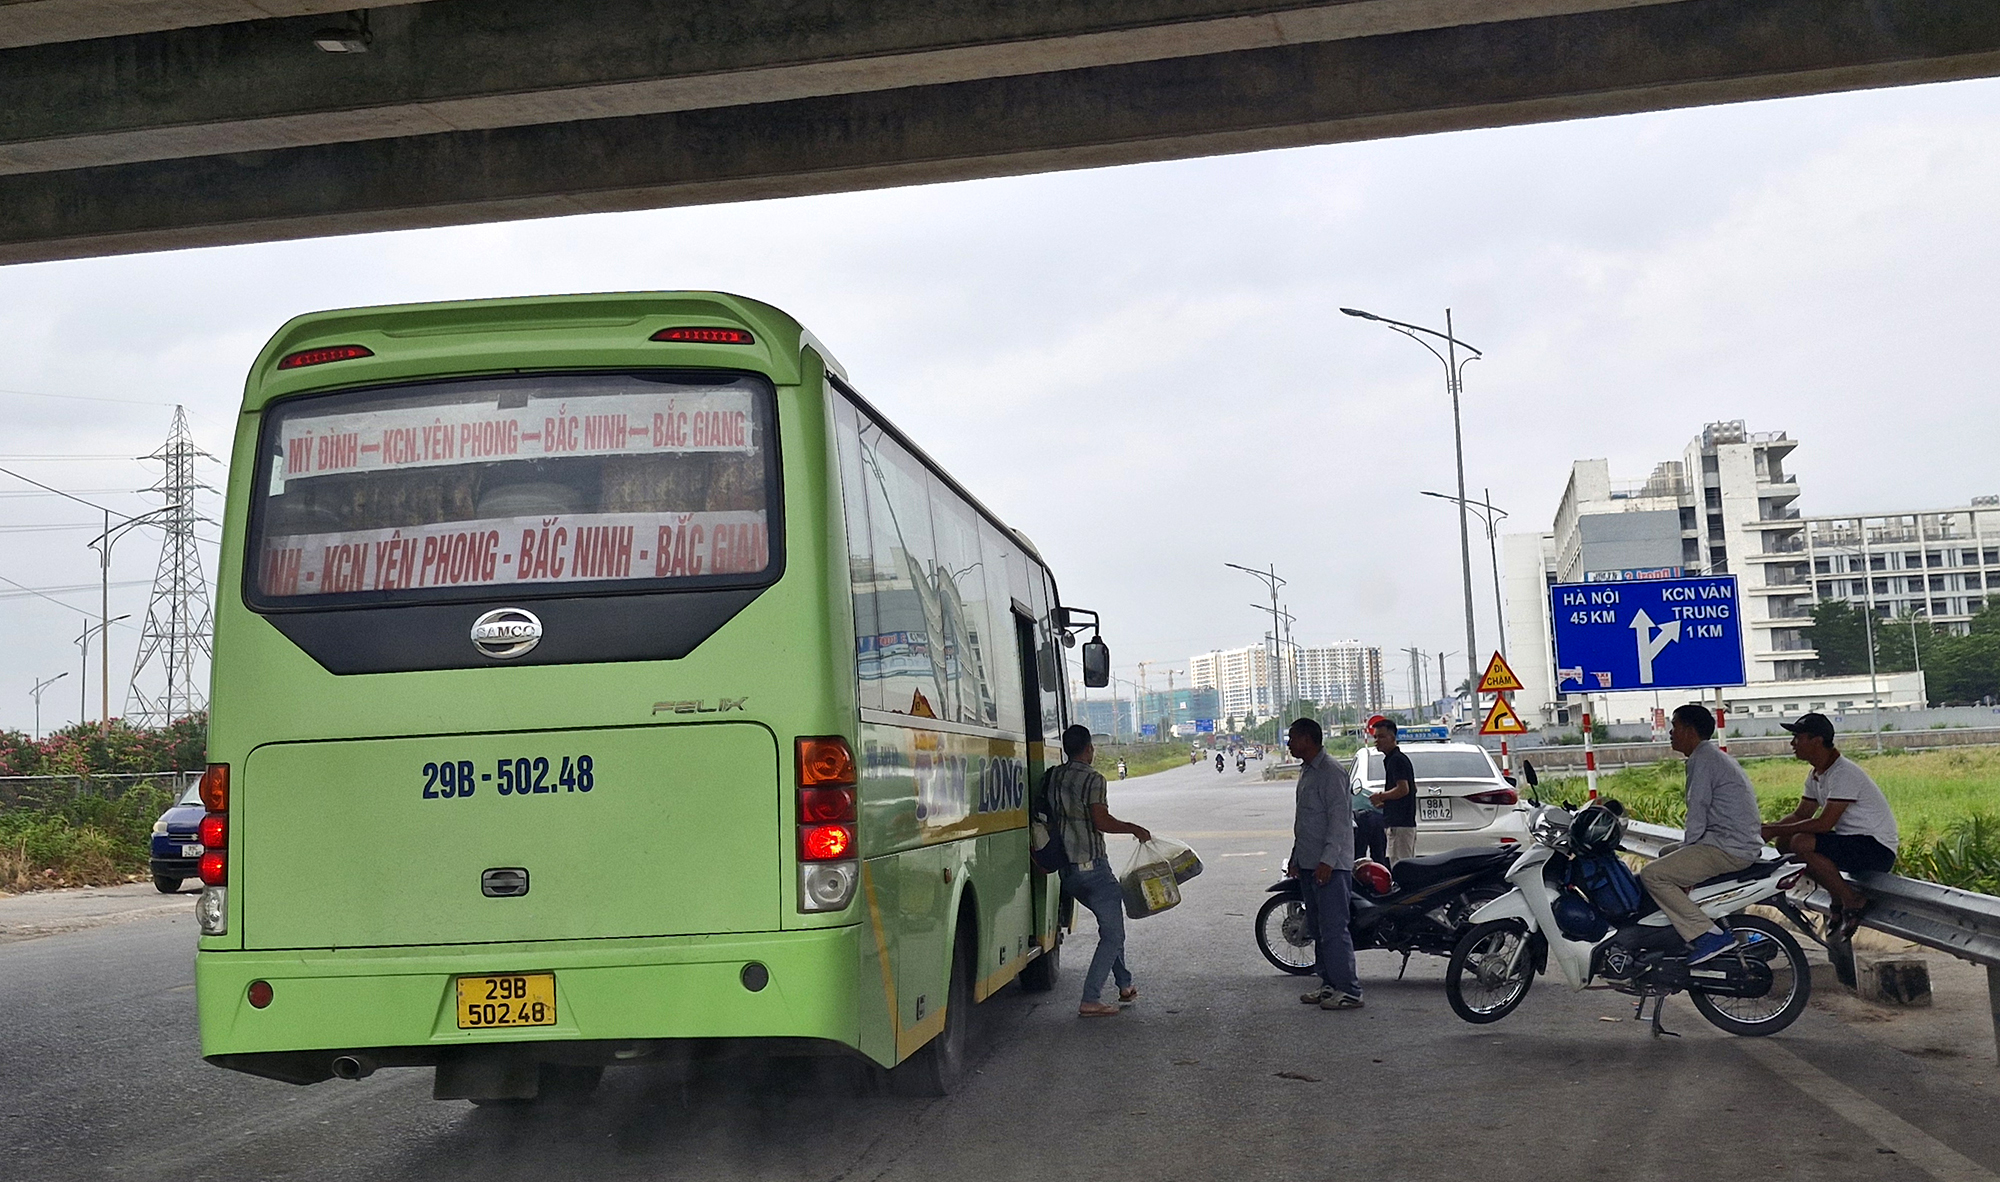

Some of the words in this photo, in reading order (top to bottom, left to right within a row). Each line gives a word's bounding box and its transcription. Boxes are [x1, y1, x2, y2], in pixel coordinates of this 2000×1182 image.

[544, 403, 580, 453] BẮC
[584, 414, 627, 451] NINH
[653, 399, 687, 448] BẮC
[692, 411, 745, 448] GIANG
[459, 419, 519, 459] PHONG
[288, 430, 314, 475] MỸ
[317, 427, 359, 471] ĐÌNH
[320, 543, 369, 594] KCN
[373, 530, 418, 591] YÊN
[418, 530, 500, 587] PHONG
[516, 517, 568, 580] BẮC
[571, 526, 634, 578] NINH
[655, 513, 704, 578] BẮC
[1563, 588, 1587, 606] HÀ
[1591, 587, 1620, 608] NỘI
[1662, 587, 1695, 602] KCN
[1698, 582, 1732, 600] VÂN
[1570, 611, 1588, 625] 45
[1590, 609, 1616, 624] KM
[1671, 604, 1730, 620] TRUNG
[475, 623, 537, 640] SAMCO
[1686, 625, 1694, 639] 1
[1697, 624, 1724, 638] KM
[1494, 664, 1503, 673] ĐI
[652, 696, 749, 716] FELIX
[978, 756, 1024, 815] LONG
[1426, 799, 1444, 809] 98A
[485, 978, 527, 1000] 29B
[468, 1001, 545, 1026] 502.48
